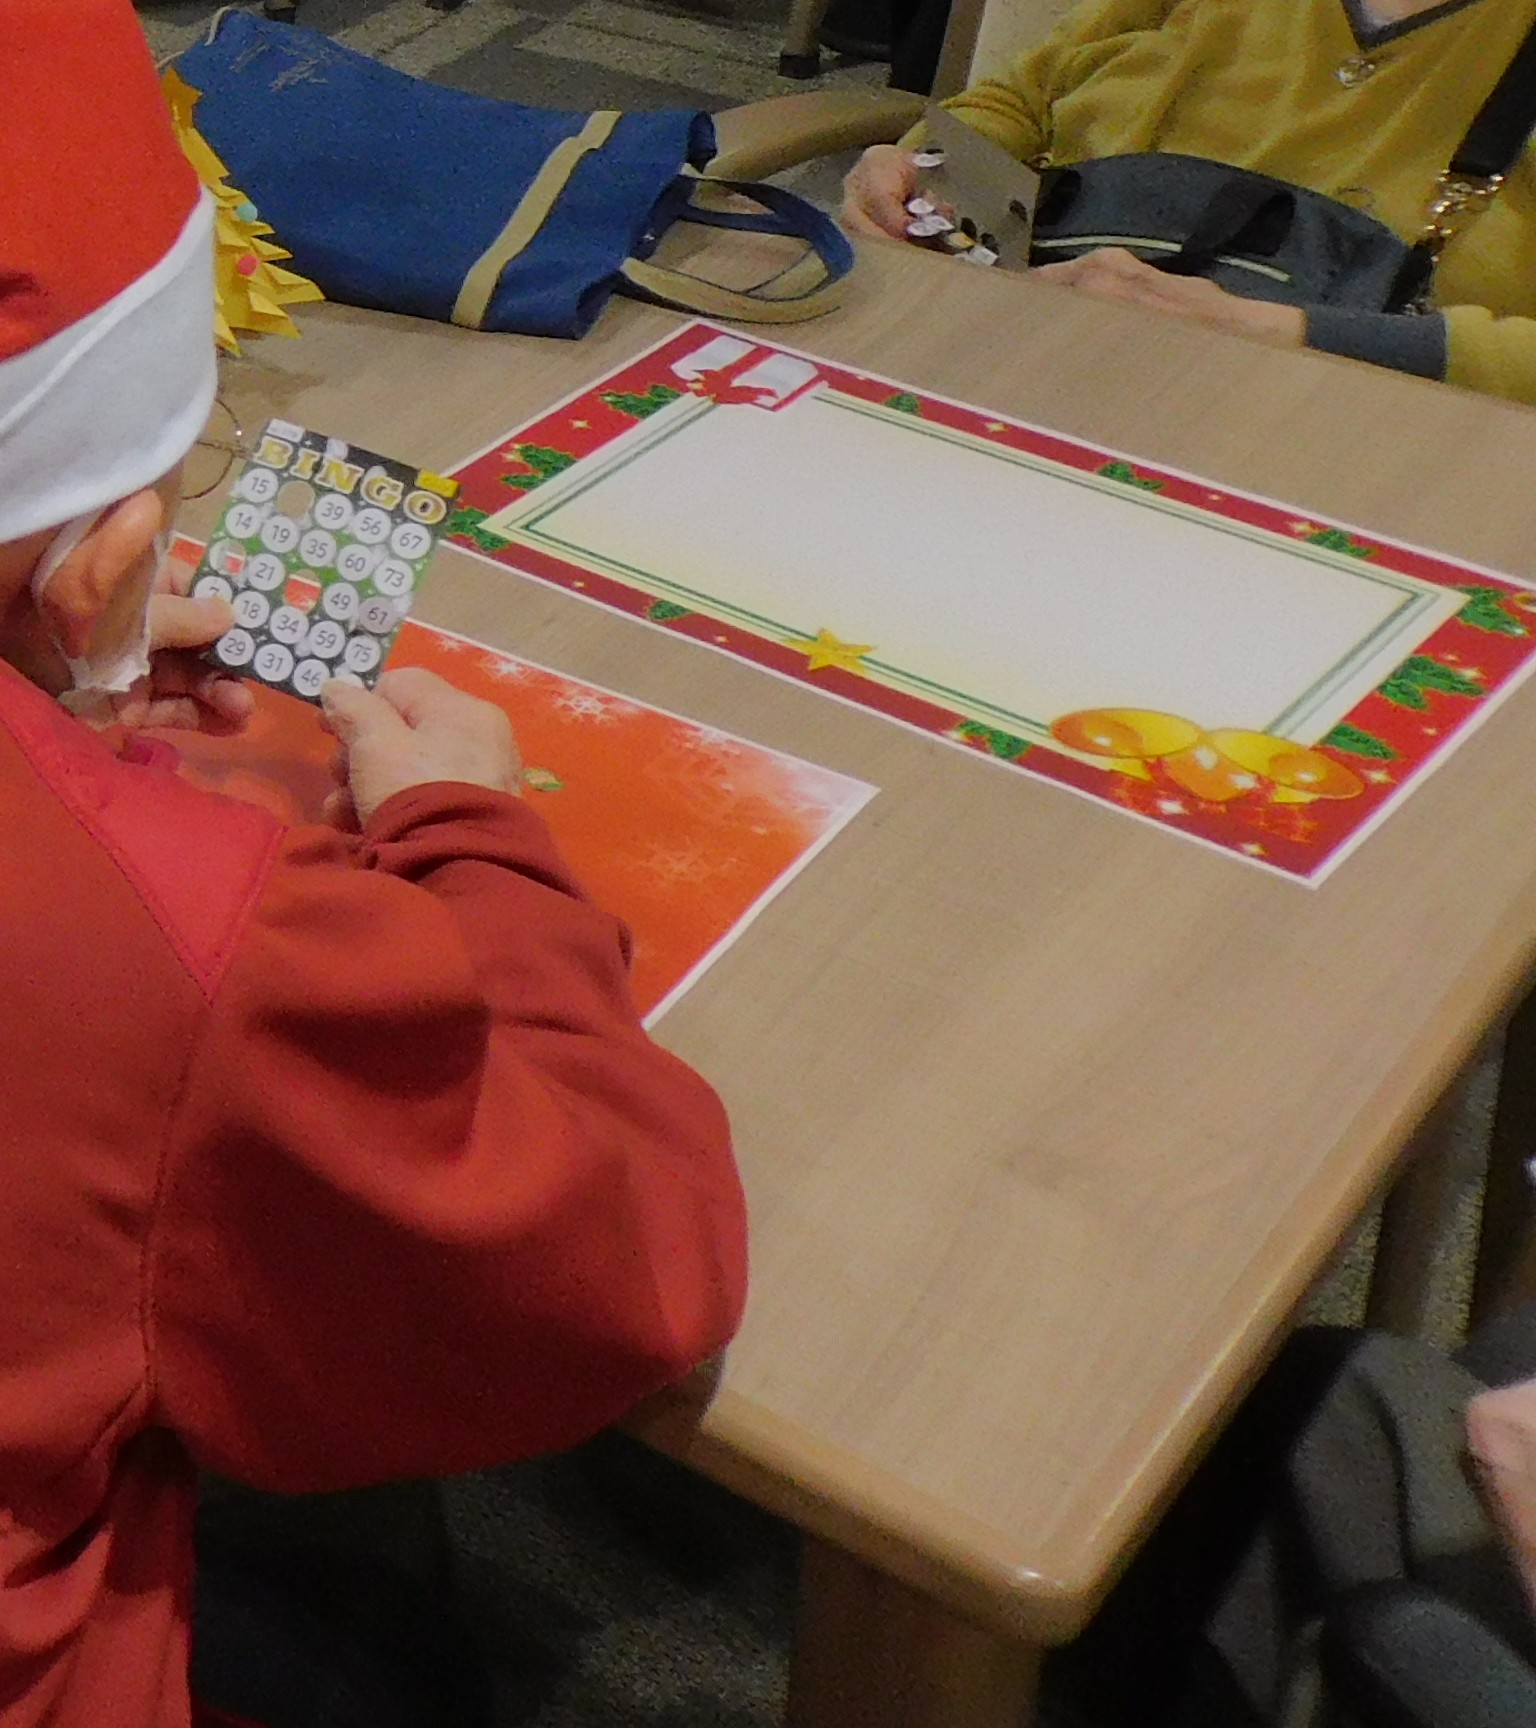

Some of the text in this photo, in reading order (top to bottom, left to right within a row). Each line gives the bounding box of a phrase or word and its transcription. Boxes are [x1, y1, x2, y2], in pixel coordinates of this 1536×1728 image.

[250, 475, 424, 550] 15 39 56 67
[252, 434, 447, 525] BINGO
[234, 511, 406, 588] 14 19 35 60 73
[254, 561, 389, 626] 21 49 61
[224, 637, 322, 688] 29 31 46
[243, 599, 261, 620] 18
[276, 613, 300, 634] 34
[315, 629, 338, 649] 59
[352, 643, 373, 663] 75
